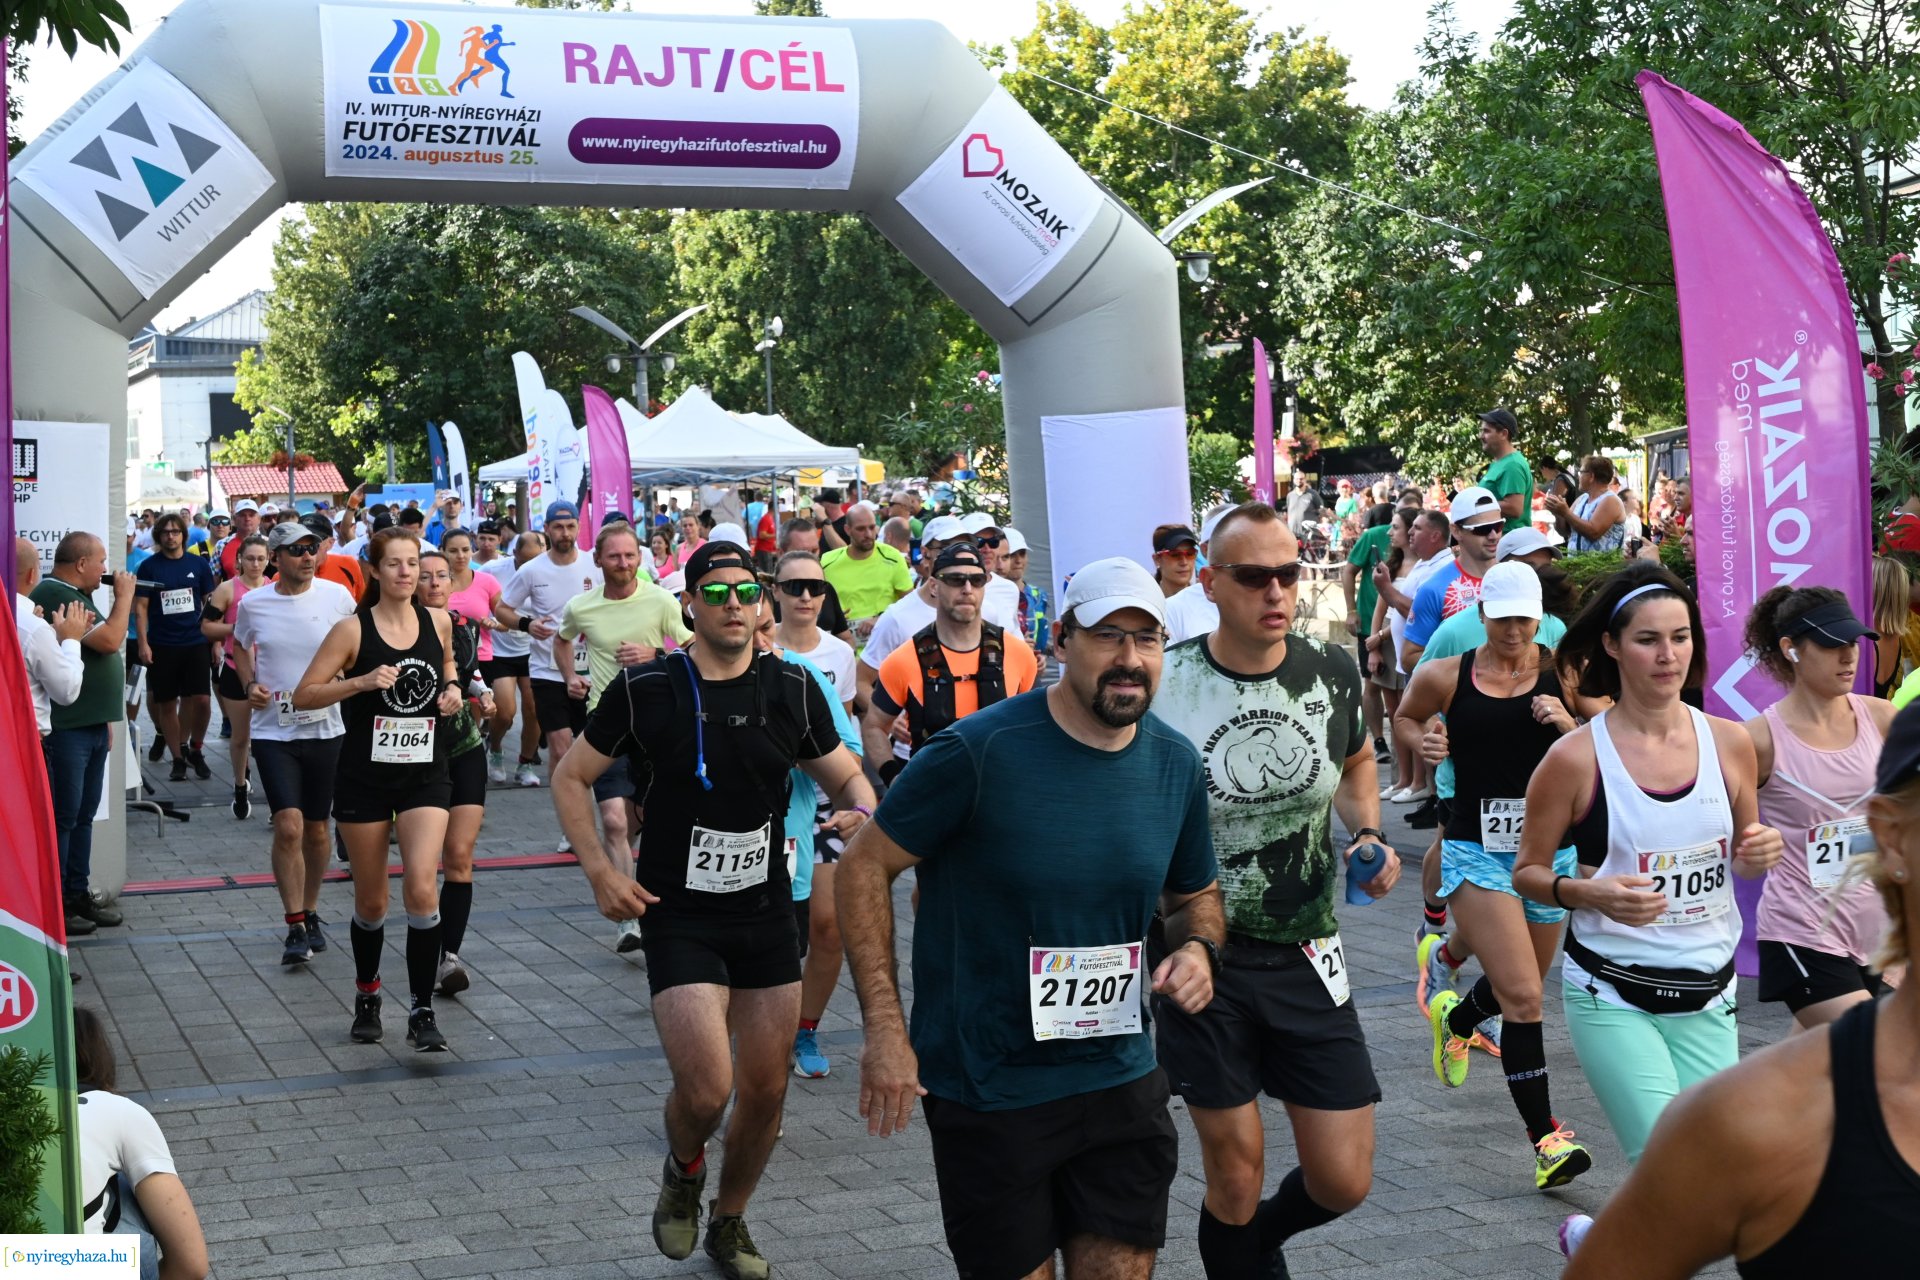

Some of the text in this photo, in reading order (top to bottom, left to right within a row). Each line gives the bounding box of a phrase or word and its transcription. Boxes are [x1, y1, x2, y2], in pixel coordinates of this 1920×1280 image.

[562, 41, 846, 93] RAJT/CÉL
[345, 102, 542, 122] IV. WITTUR-NYÍREGYHÁZI
[343, 117, 542, 147] FUTÓFESZTIVÁL
[342, 144, 539, 165] 2024. augusztus 25.
[582, 135, 828, 155] www.nyiregyhazifutofesztival.hu
[156, 184, 221, 242] WITTUR
[995, 168, 1069, 240] MOZAIK
[1036, 227, 1058, 247] med
[165, 596, 192, 607] 21039
[1304, 700, 1326, 716] 575
[378, 732, 430, 747] 21064
[1203, 708, 1316, 754] NAKED WARRIOR TEAM
[695, 846, 766, 872] 21159
[1651, 863, 1725, 898] 21058
[1039, 973, 1134, 1007] 21207
[1656, 989, 1680, 998] BISA
